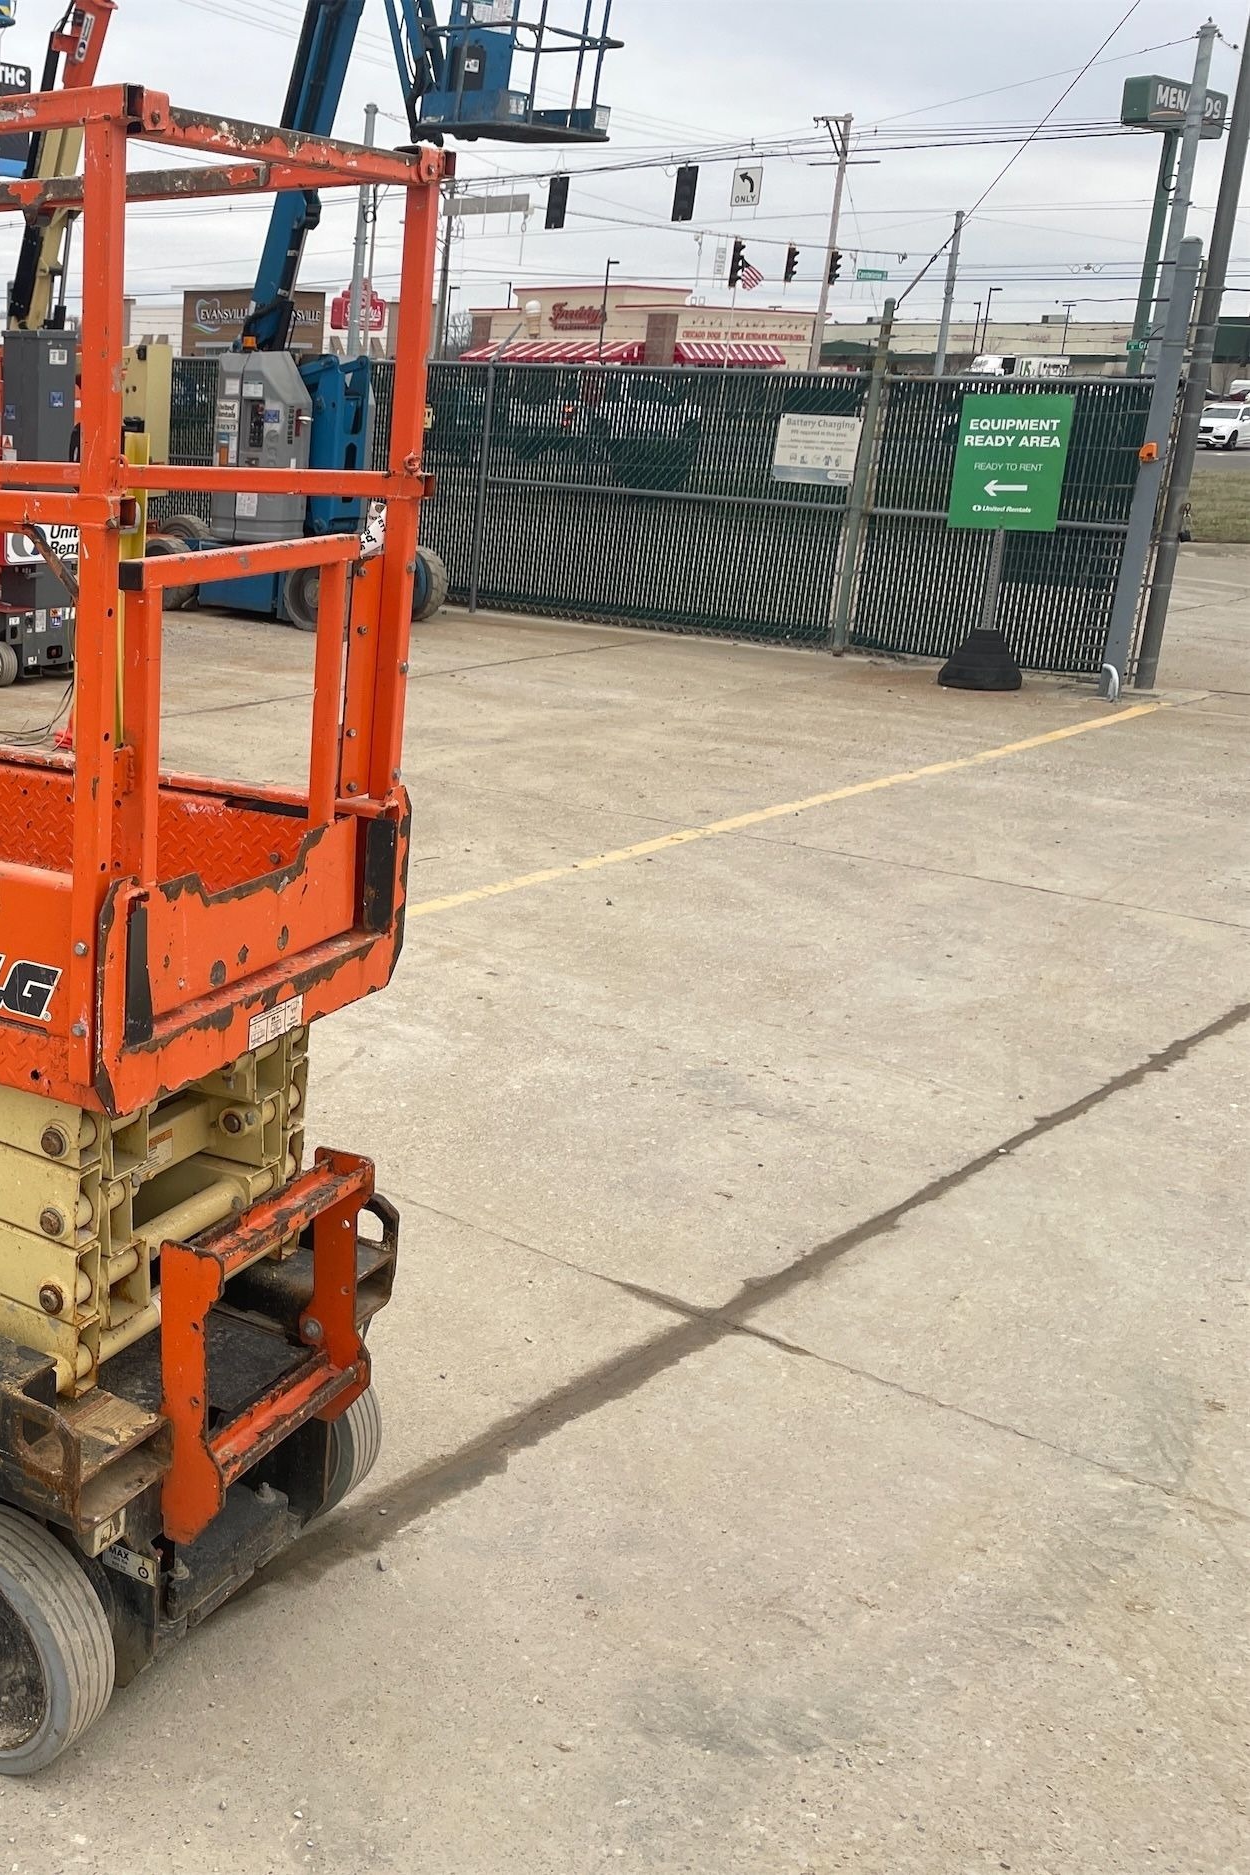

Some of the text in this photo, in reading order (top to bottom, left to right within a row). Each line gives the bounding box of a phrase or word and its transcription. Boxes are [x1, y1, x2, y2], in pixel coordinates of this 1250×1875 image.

[1155, 83, 1222, 120] MENDS
[733, 194, 757, 205] ONLY
[200, 308, 250, 321] EVANSVILL
[786, 417, 856, 432] Battery Charging
[969, 418, 1061, 432] EQUIPMENT
[963, 434, 1062, 449] READY AREA
[973, 461, 1044, 473] READY TO RENT
[982, 505, 1032, 514] United Rentals
[49, 524, 79, 539] Unit
[49, 540, 79, 555] Rent
